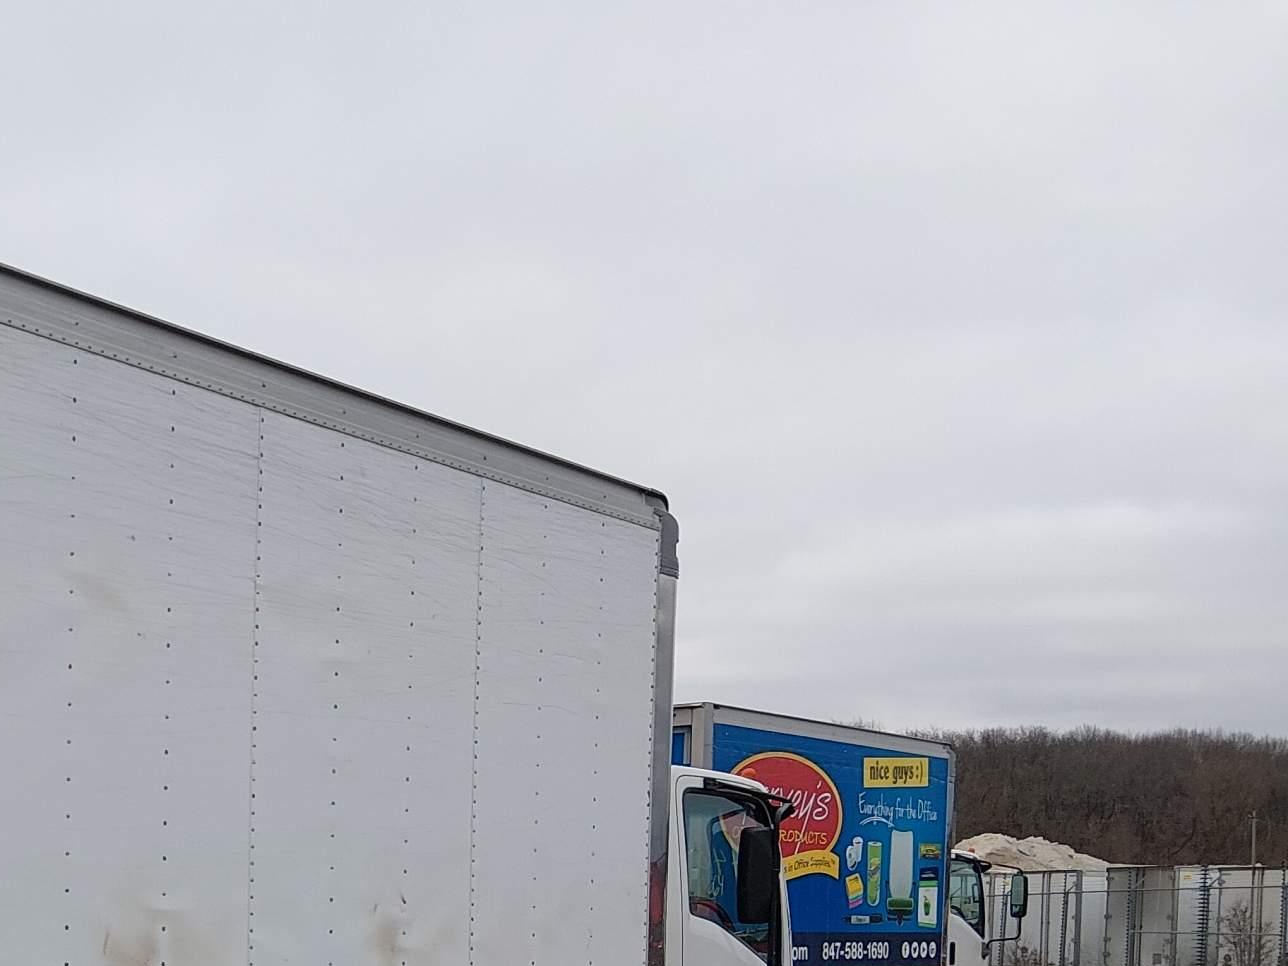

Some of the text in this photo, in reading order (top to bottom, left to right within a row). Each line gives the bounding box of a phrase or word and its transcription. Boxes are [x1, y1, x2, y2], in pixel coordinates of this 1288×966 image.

[869, 760, 890, 781] nice
[858, 791, 894, 828] Everything
[894, 797, 905, 820] for
[906, 796, 917, 819] the
[779, 829, 828, 845] RODUCTS
[791, 941, 890, 961] om 847-588-1690
